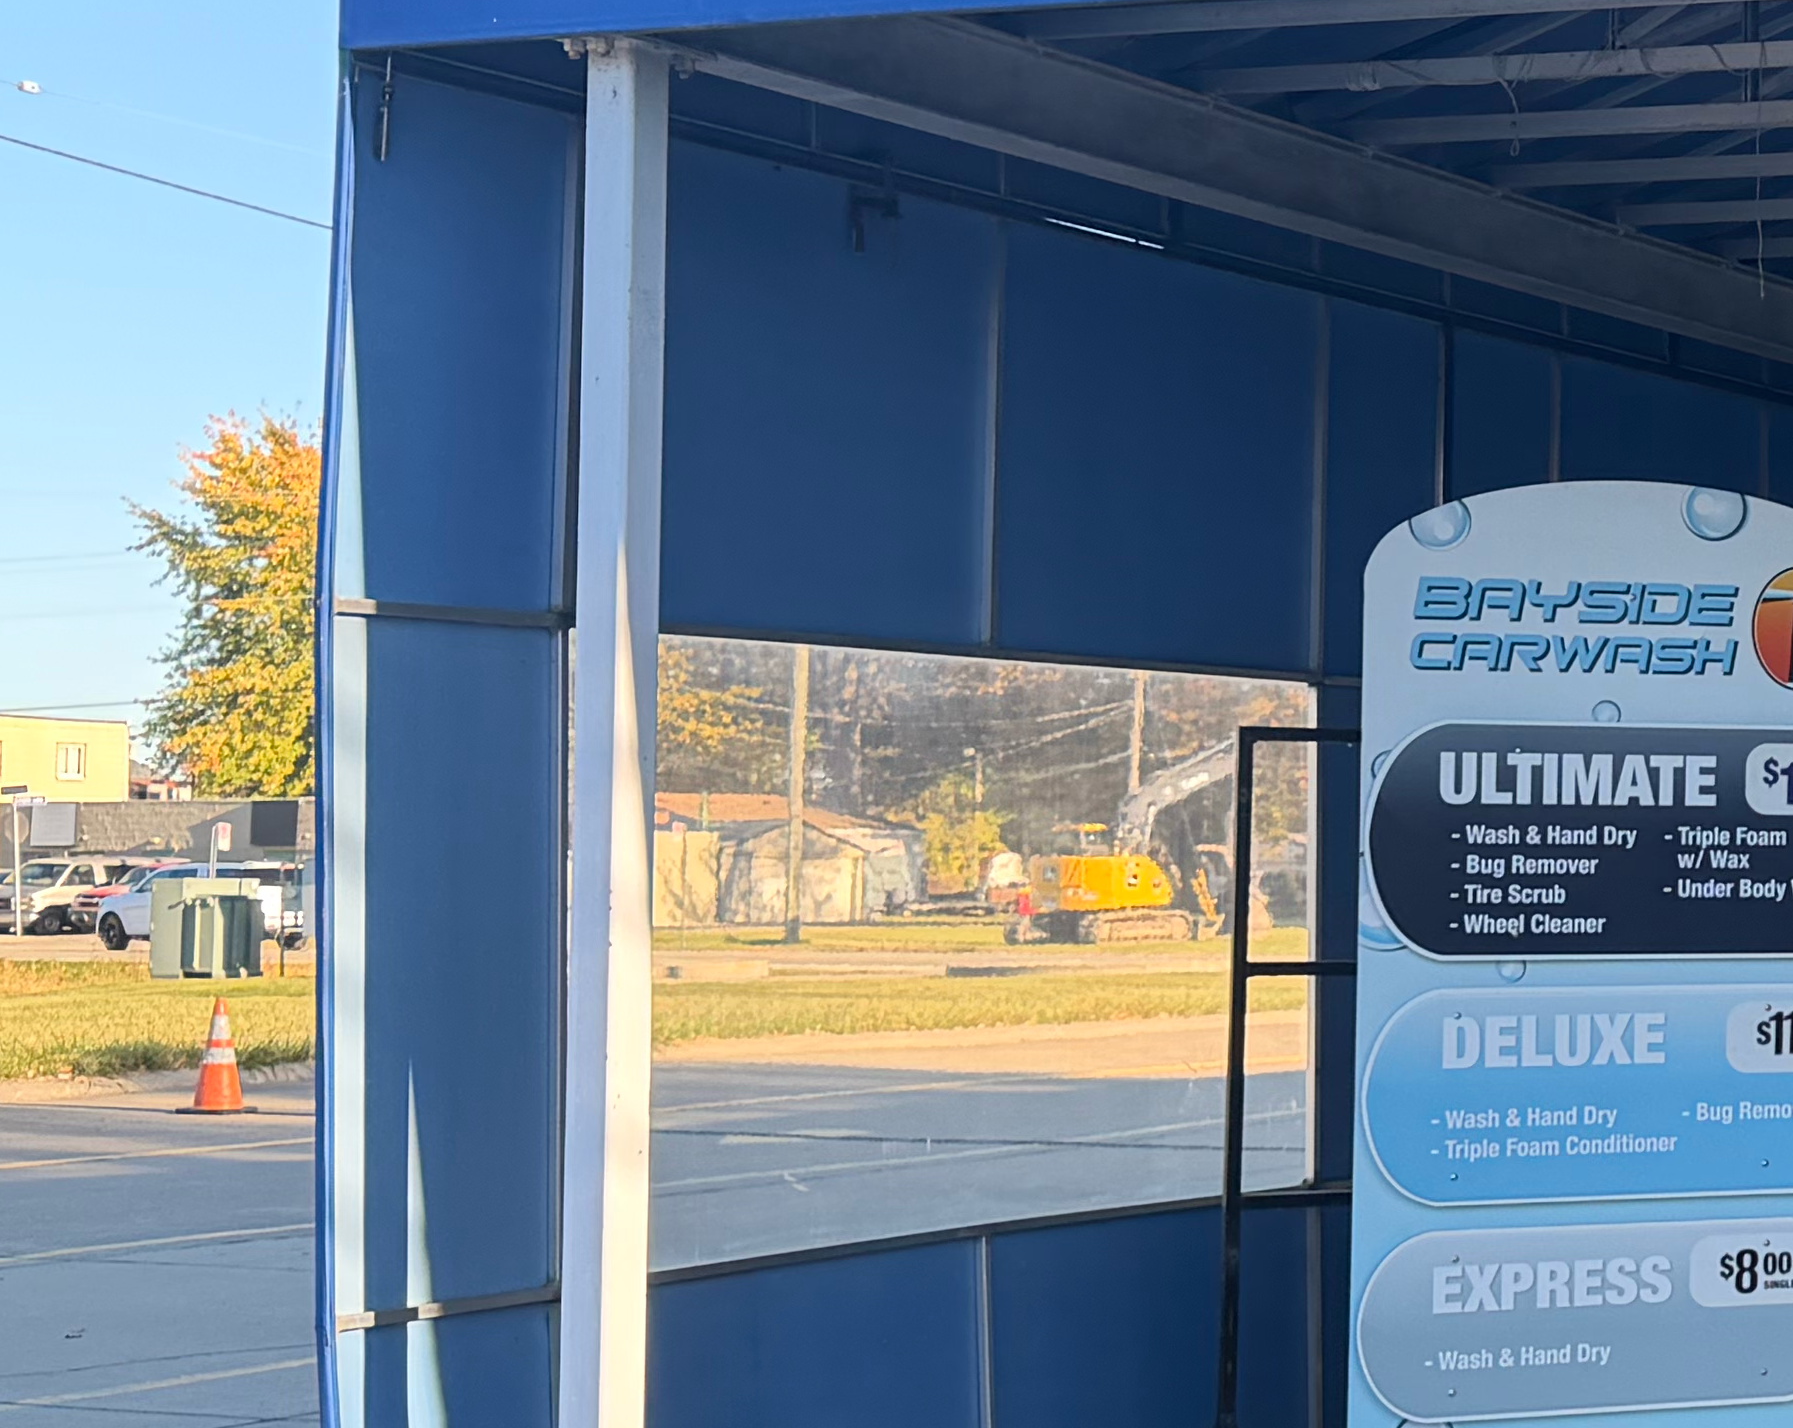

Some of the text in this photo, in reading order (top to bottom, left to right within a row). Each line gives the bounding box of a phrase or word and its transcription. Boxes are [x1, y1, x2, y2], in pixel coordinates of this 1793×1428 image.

[1412, 576, 1739, 626] BAYSIDE
[1409, 632, 1738, 675] CARWASH
[1439, 751, 1717, 807] ULTIMATE
[1466, 825, 1638, 850] Wash & Hand Dry
[1677, 826, 1788, 849] Triple Foam
[1466, 855, 1599, 878] Bug Remover
[1677, 849, 1750, 870] w/ Wax
[1464, 884, 1566, 905] Tire Scrub
[1677, 878, 1735, 899] Under
[1739, 878, 1787, 903] Body
[1463, 914, 1606, 935] Wheel Cleaner
[1442, 1012, 1666, 1069] DELUXE
[1445, 1106, 1618, 1129] Wash & Hand Dry
[1696, 1102, 1733, 1125] Bug
[1445, 1134, 1677, 1163] Triple Foam Conditioner
[1432, 1255, 1673, 1314] EXPRESS
[1438, 1343, 1612, 1370] Wash & Hand Dry
